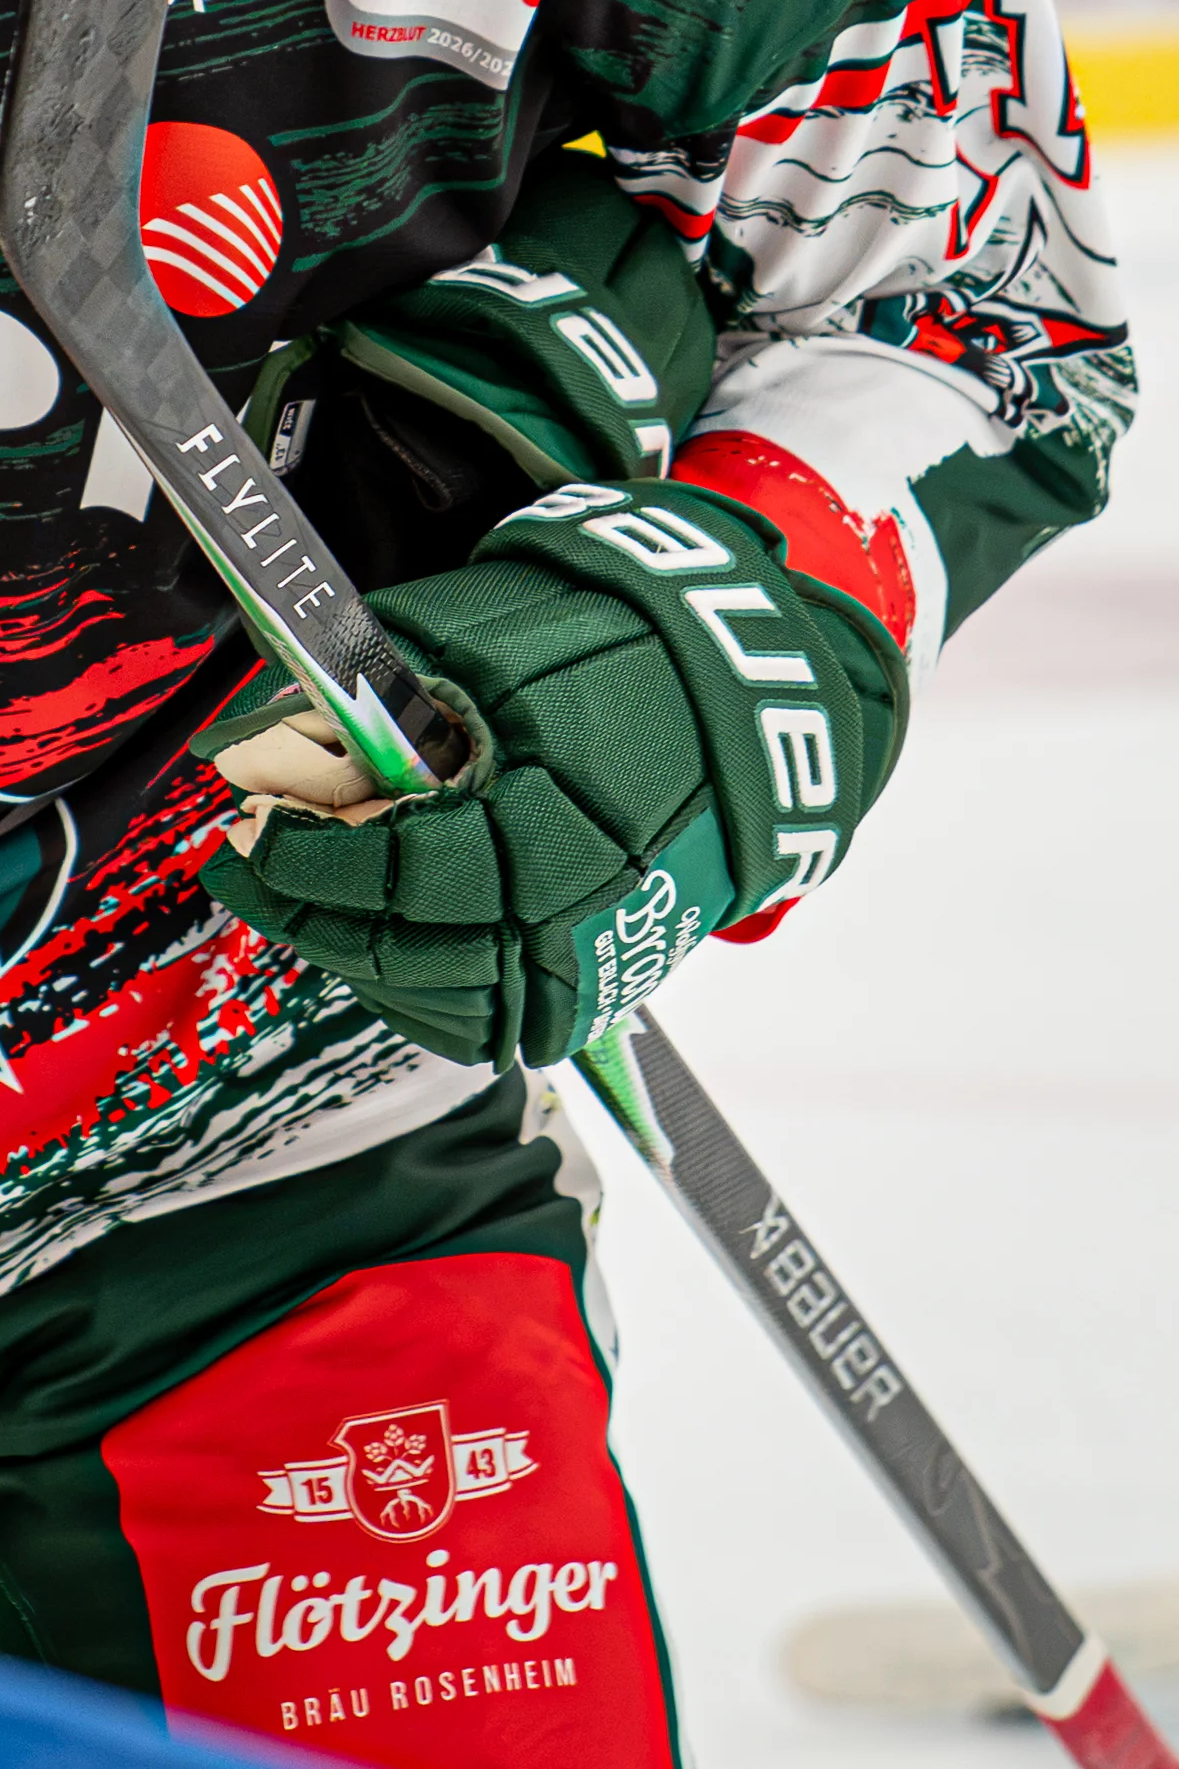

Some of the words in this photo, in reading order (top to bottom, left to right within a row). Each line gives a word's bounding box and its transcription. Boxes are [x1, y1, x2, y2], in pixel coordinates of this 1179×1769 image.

[351, 21, 427, 43] HERZBLUT
[175, 423, 335, 619] FLYLITE
[594, 930, 616, 962] GUT
[303, 1477, 334, 1506] 15
[465, 1447, 497, 1480] 43
[186, 1549, 618, 1682] Flötzinger
[281, 1686, 370, 1731] BRÄU
[391, 1658, 577, 1710] ROSENHEIM
